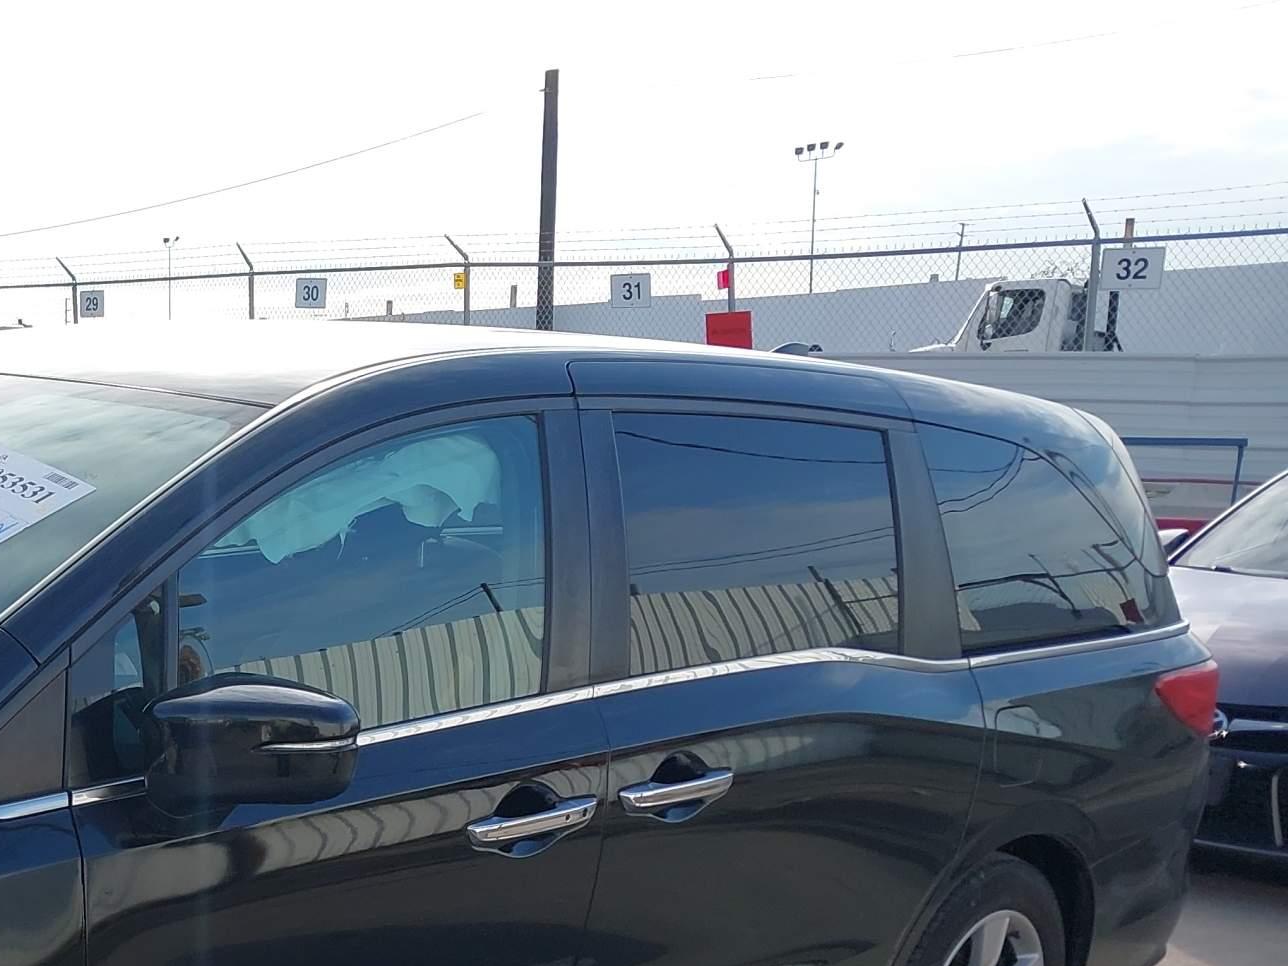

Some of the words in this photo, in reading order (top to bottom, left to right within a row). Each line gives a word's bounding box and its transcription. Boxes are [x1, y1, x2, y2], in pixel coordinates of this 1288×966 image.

[1116, 257, 1149, 280] 32
[302, 285, 319, 301] 30
[622, 281, 642, 300] 31
[85, 297, 98, 312] 29
